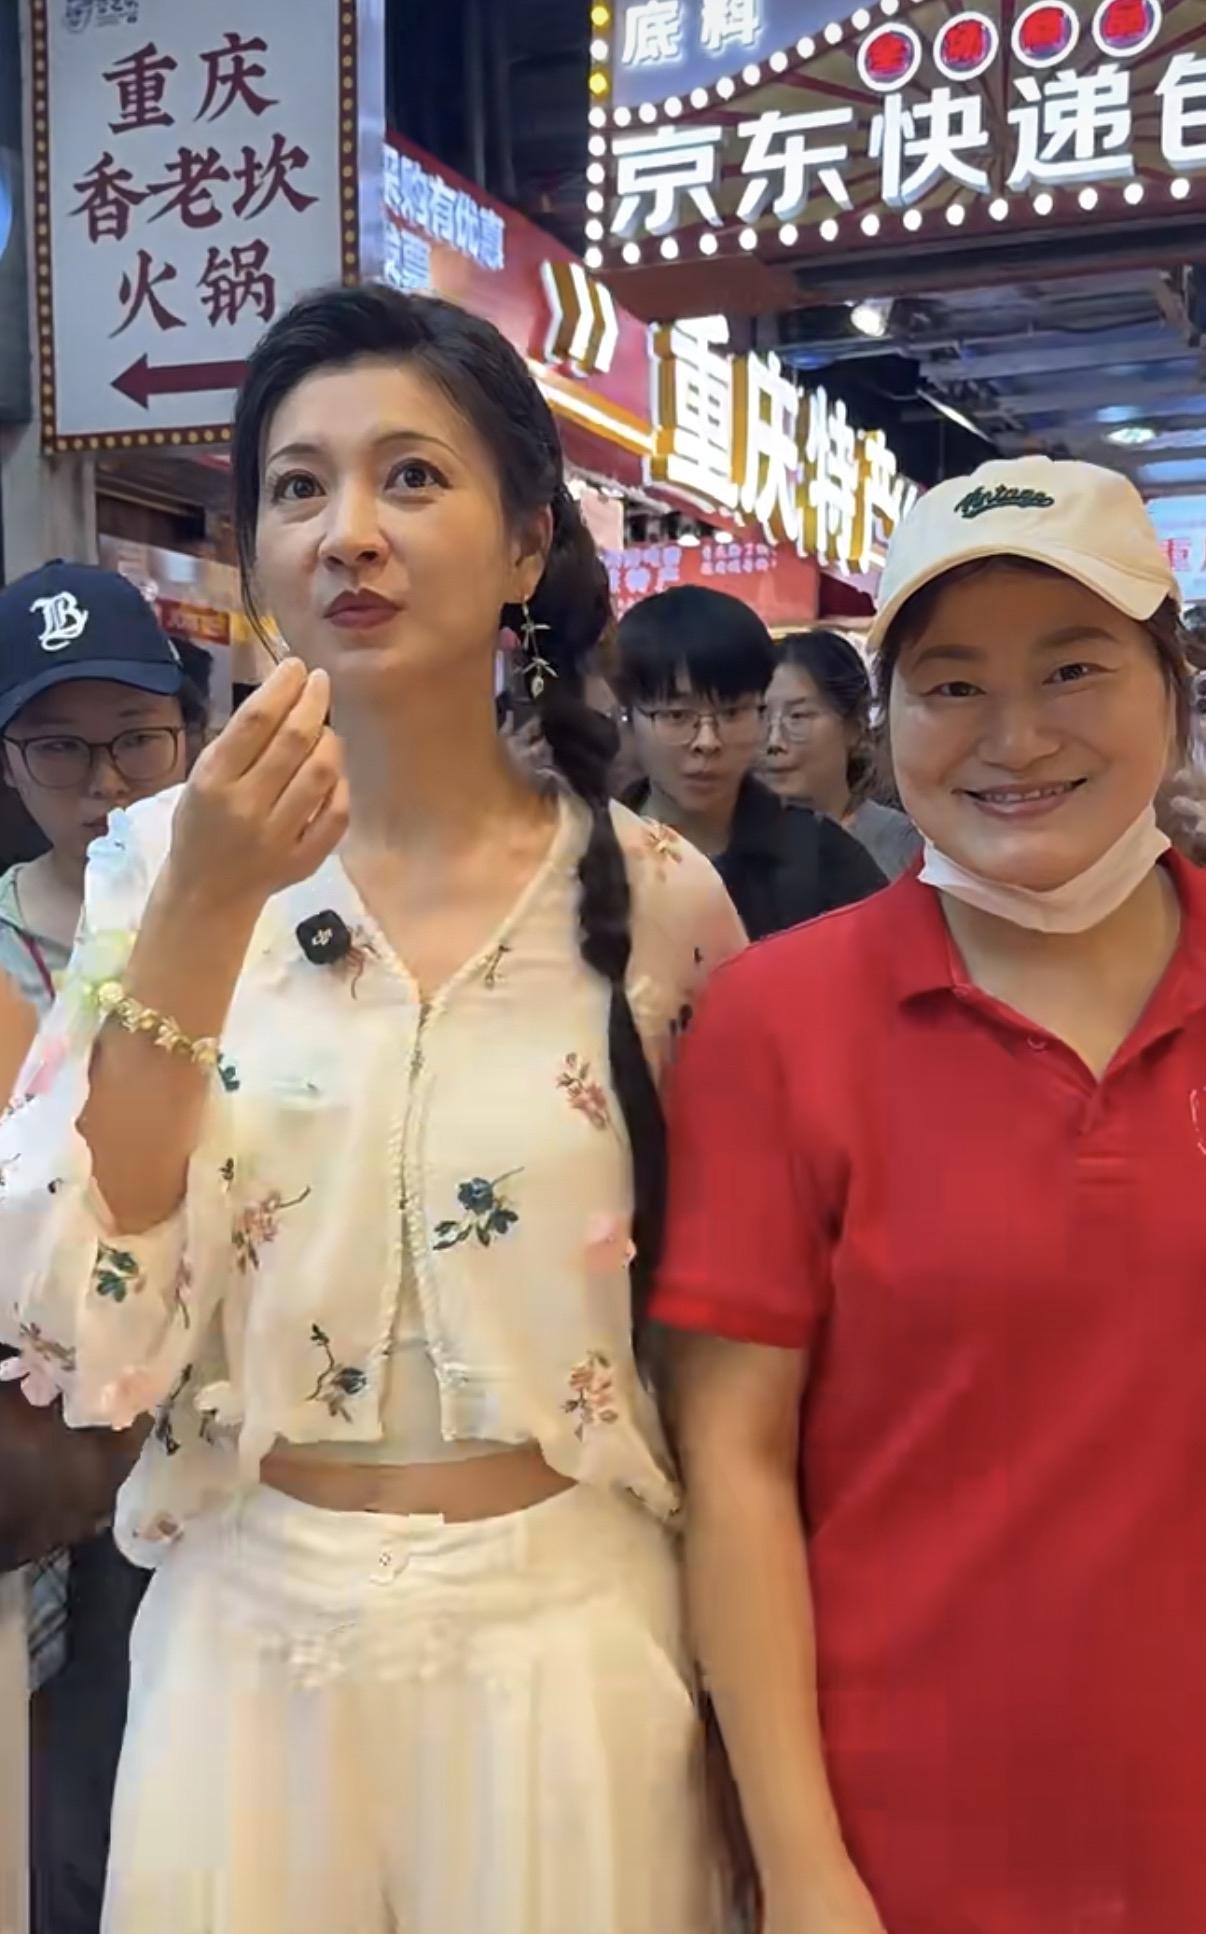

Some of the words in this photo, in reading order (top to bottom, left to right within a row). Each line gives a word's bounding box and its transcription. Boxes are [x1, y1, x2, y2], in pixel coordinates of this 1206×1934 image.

[102, 32, 280, 134] 重庆
[621, 0, 761, 65] 底料
[67, 132, 319, 244] 香老坎
[108, 238, 275, 339] 火锅
[650, 313, 902, 577] 重庆特产
[29, 590, 89, 651] B
